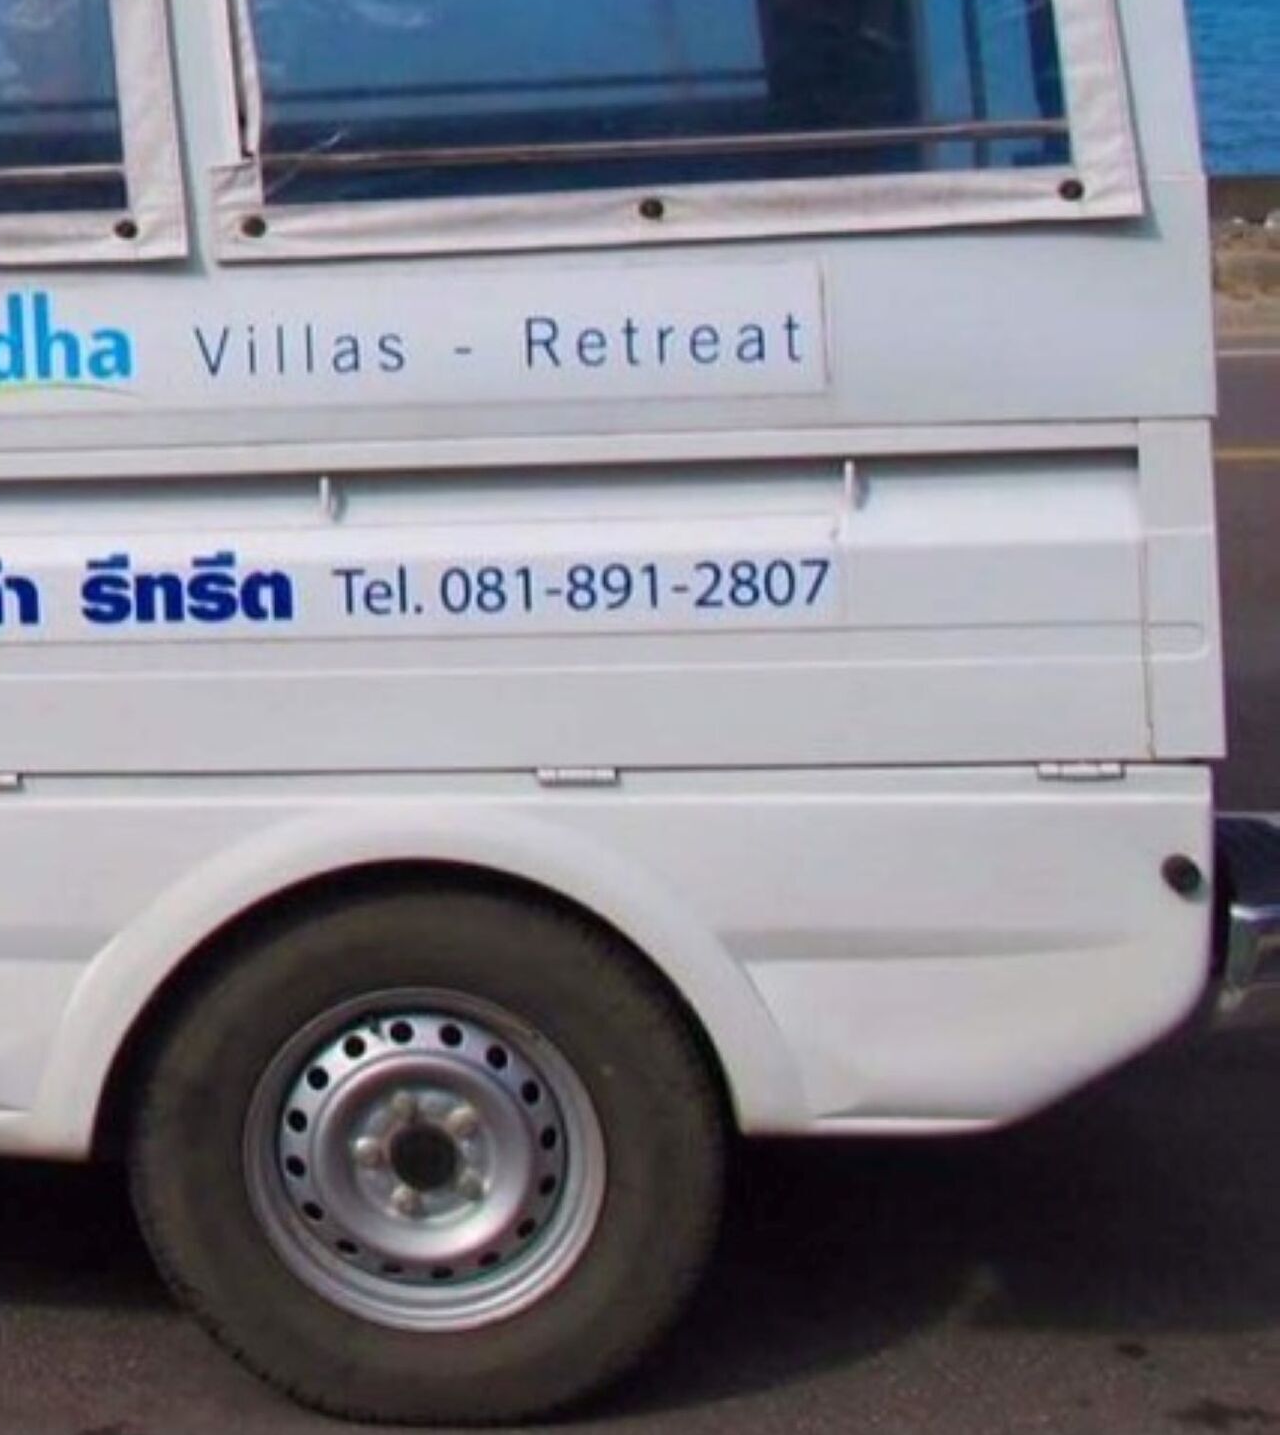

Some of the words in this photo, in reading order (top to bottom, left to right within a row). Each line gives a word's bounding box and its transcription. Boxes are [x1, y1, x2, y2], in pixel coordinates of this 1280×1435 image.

[193, 323, 408, 377] Villas
[523, 312, 805, 370] Retreat
[80, 551, 294, 625] รีทรีต
[331, 563, 424, 616] Tel.
[439, 557, 832, 615] 081-891-2807
